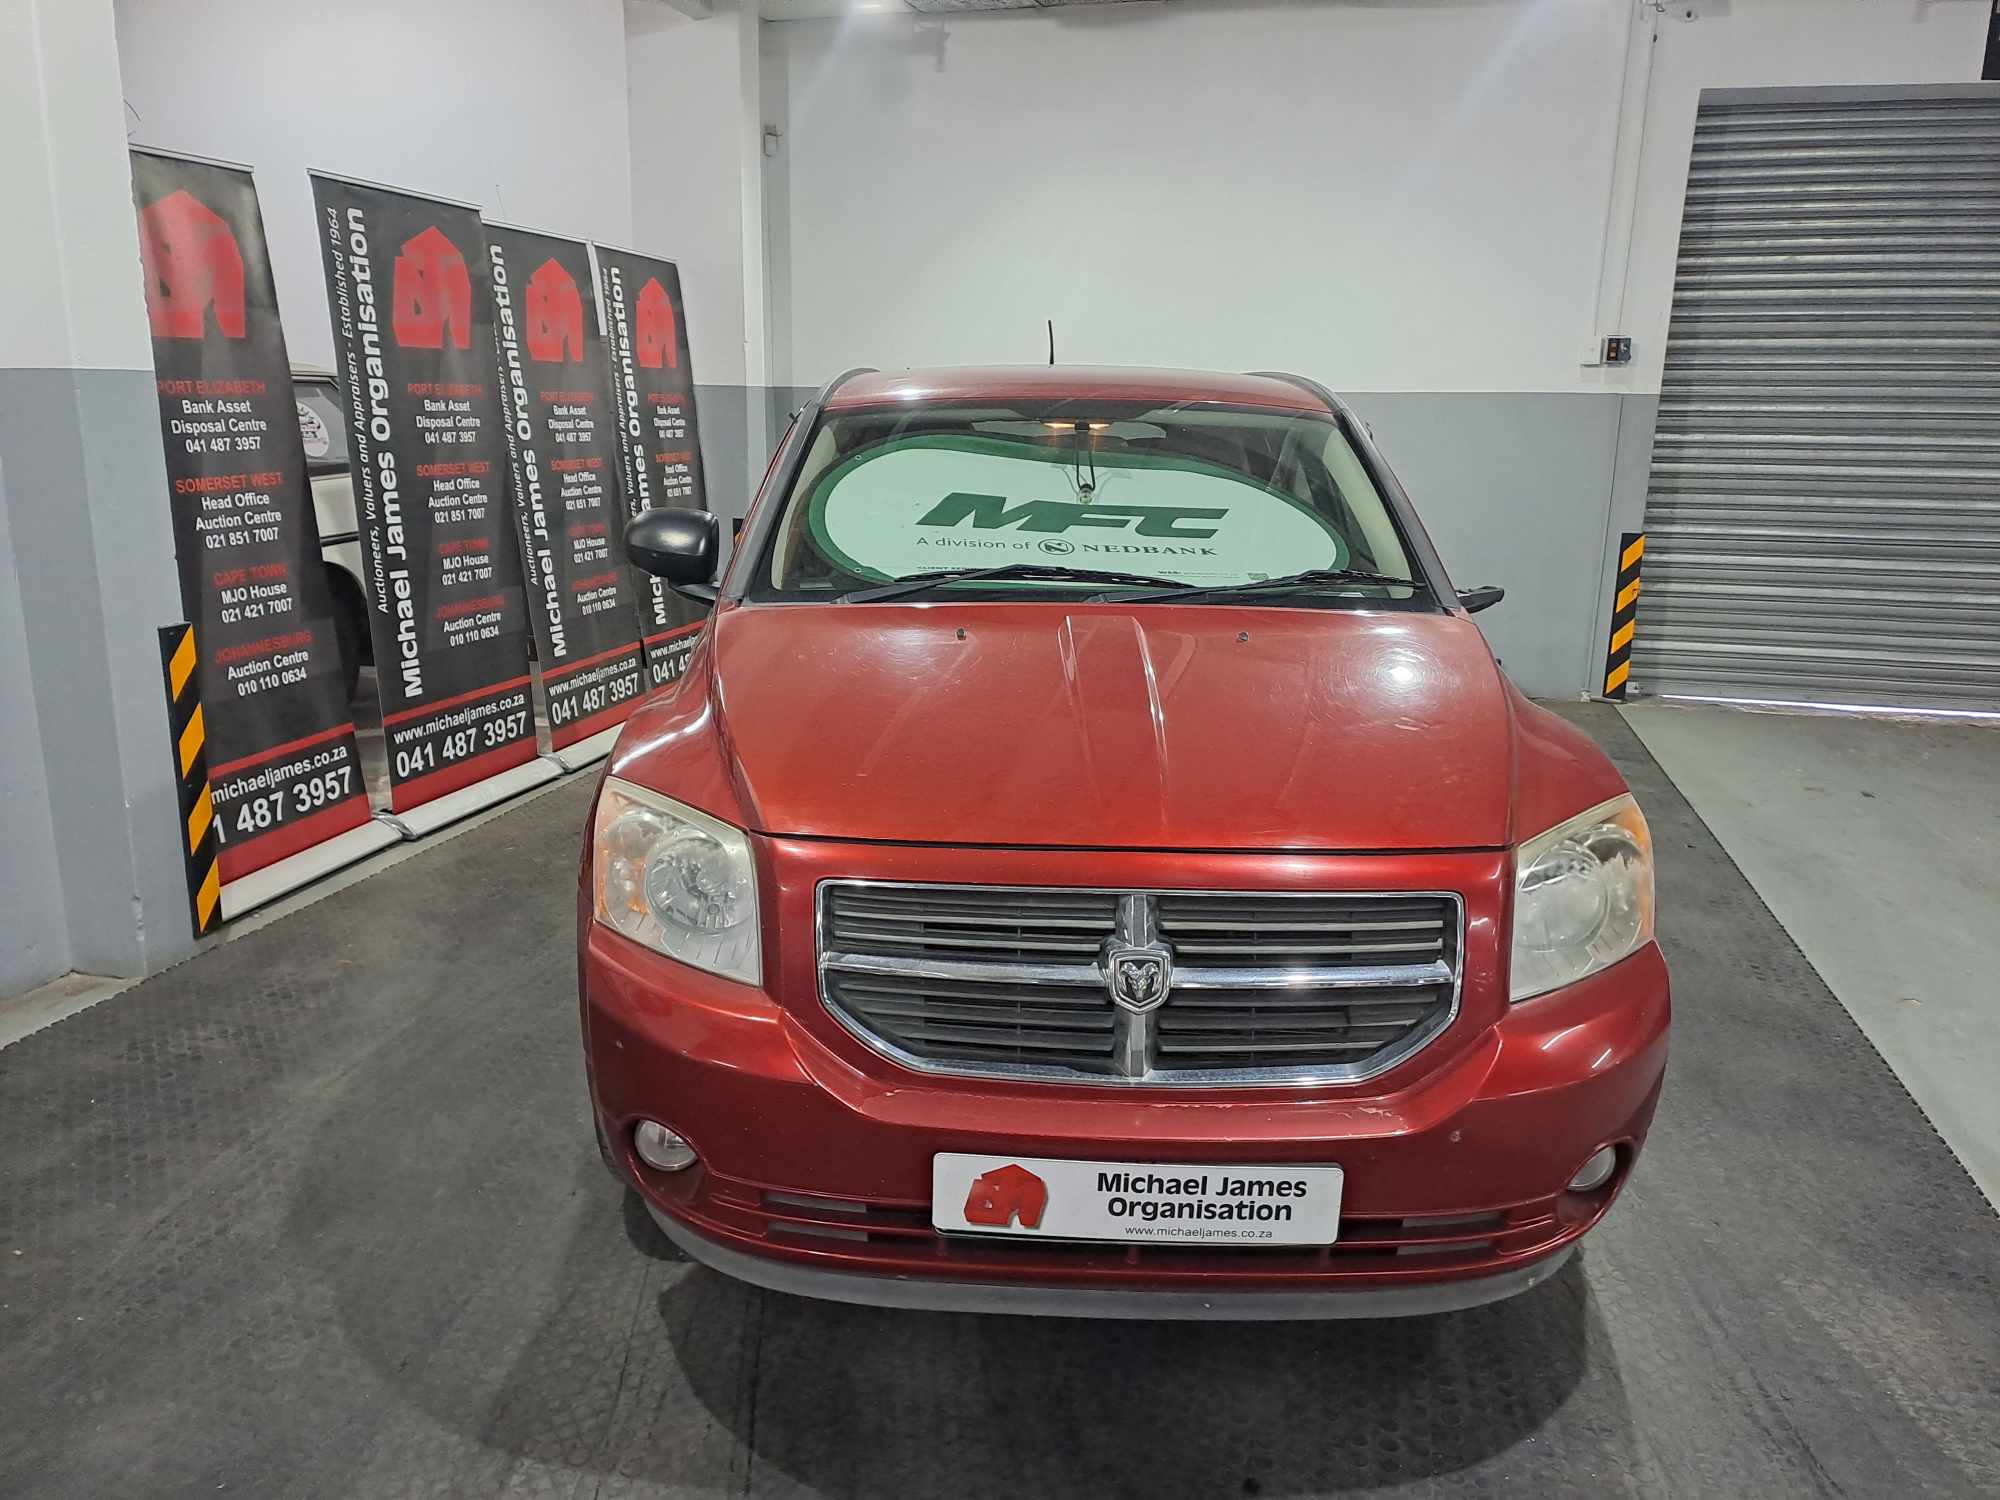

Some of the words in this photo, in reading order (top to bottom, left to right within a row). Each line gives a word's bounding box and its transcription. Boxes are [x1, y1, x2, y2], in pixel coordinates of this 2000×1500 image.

[327, 207, 342, 246] 1964
[333, 251, 354, 338] Established
[347, 207, 391, 442] Organisation
[490, 245, 532, 441] Organisation
[610, 267, 640, 437] Organisation
[348, 351, 366, 431] Appraisers
[498, 366, 513, 432] Appraisers
[182, 399, 214, 414] Bank
[217, 399, 252, 413] Asset
[424, 399, 446, 411] Bank
[448, 399, 471, 411] Asset
[569, 404, 587, 416] Asset
[171, 419, 226, 436] Disposal
[229, 418, 267, 432] Centre
[415, 415, 454, 430] Disposal
[456, 415, 481, 428] Centre
[186, 438, 207, 453] 041
[210, 437, 231, 452] 487
[235, 436, 261, 451] 3957
[355, 433, 369, 463] and
[425, 432, 440, 444] 041
[442, 431, 456, 443] 487
[459, 431, 476, 443] 3957
[506, 434, 517, 458] and
[175, 474, 247, 493] SOMERSET
[251, 471, 283, 487] WEST
[433, 479, 455, 491] Head
[457, 477, 480, 490] Office
[512, 463, 525, 507] Valuers
[578, 471, 596, 482] Office
[633, 444, 651, 512] ames
[201, 495, 232, 511] Head
[234, 492, 270, 507] Office
[363, 467, 377, 520] Valuers
[377, 451, 406, 561] James
[428, 495, 461, 508] Auction
[463, 493, 488, 506] Centre
[523, 449, 549, 541] James
[195, 513, 242, 531] Auction
[244, 510, 282, 525] Centre
[434, 511, 449, 524] 021
[451, 510, 465, 522] 851
[467, 508, 485, 520] 7007
[915, 491, 1230, 539] MFC
[205, 533, 226, 549] 021
[229, 531, 250, 546] 851
[252, 527, 279, 542] 7007
[521, 511, 539, 585] Auctioneers,
[916, 537, 929, 546] A
[935, 537, 1006, 550] division
[1012, 541, 1031, 551] of
[1082, 544, 1218, 556] NEDBANK
[369, 525, 389, 614] Auctioneers,
[443, 556, 461, 569] MJO
[463, 554, 489, 567] House
[442, 573, 456, 586] 021
[458, 570, 472, 583] 421
[474, 567, 492, 580] 7007
[221, 588, 247, 604] MJO
[250, 583, 287, 599] House
[537, 549, 567, 657] Michael
[577, 590, 598, 604] Auction
[598, 586, 617, 598] Centre
[221, 608, 242, 623] 021
[244, 603, 265, 619] 421
[268, 598, 293, 614] 7007
[444, 617, 474, 632] Auction
[476, 612, 501, 625] Centre
[389, 569, 424, 698] Michael
[450, 634, 464, 646] 010
[466, 630, 479, 642] 110
[481, 625, 499, 639] 0634
[227, 660, 271, 680] Auction
[273, 650, 309, 668] Centre
[549, 657, 637, 697] www.michaeljames.co.za
[652, 659, 675, 683] 041
[237, 681, 257, 697] 010
[260, 674, 279, 691] 110
[281, 667, 307, 685] 0634
[552, 695, 579, 725] 041
[582, 684, 606, 712] 487
[609, 672, 639, 702] 3957
[394, 693, 525, 745] www.michaeljames.co.za
[396, 742, 435, 778] 041
[442, 727, 477, 760] 487
[483, 710, 526, 746] 3957
[211, 745, 348, 805] michaeljames.co.za
[236, 791, 285, 833] 487
[292, 765, 351, 812] 3957
[1097, 1172, 1208, 1195] Michael
[1215, 1176, 1308, 1197] James
[1108, 1197, 1292, 1221] Organisation
[1125, 1225, 1273, 1239] www.michaeljames.co.za
